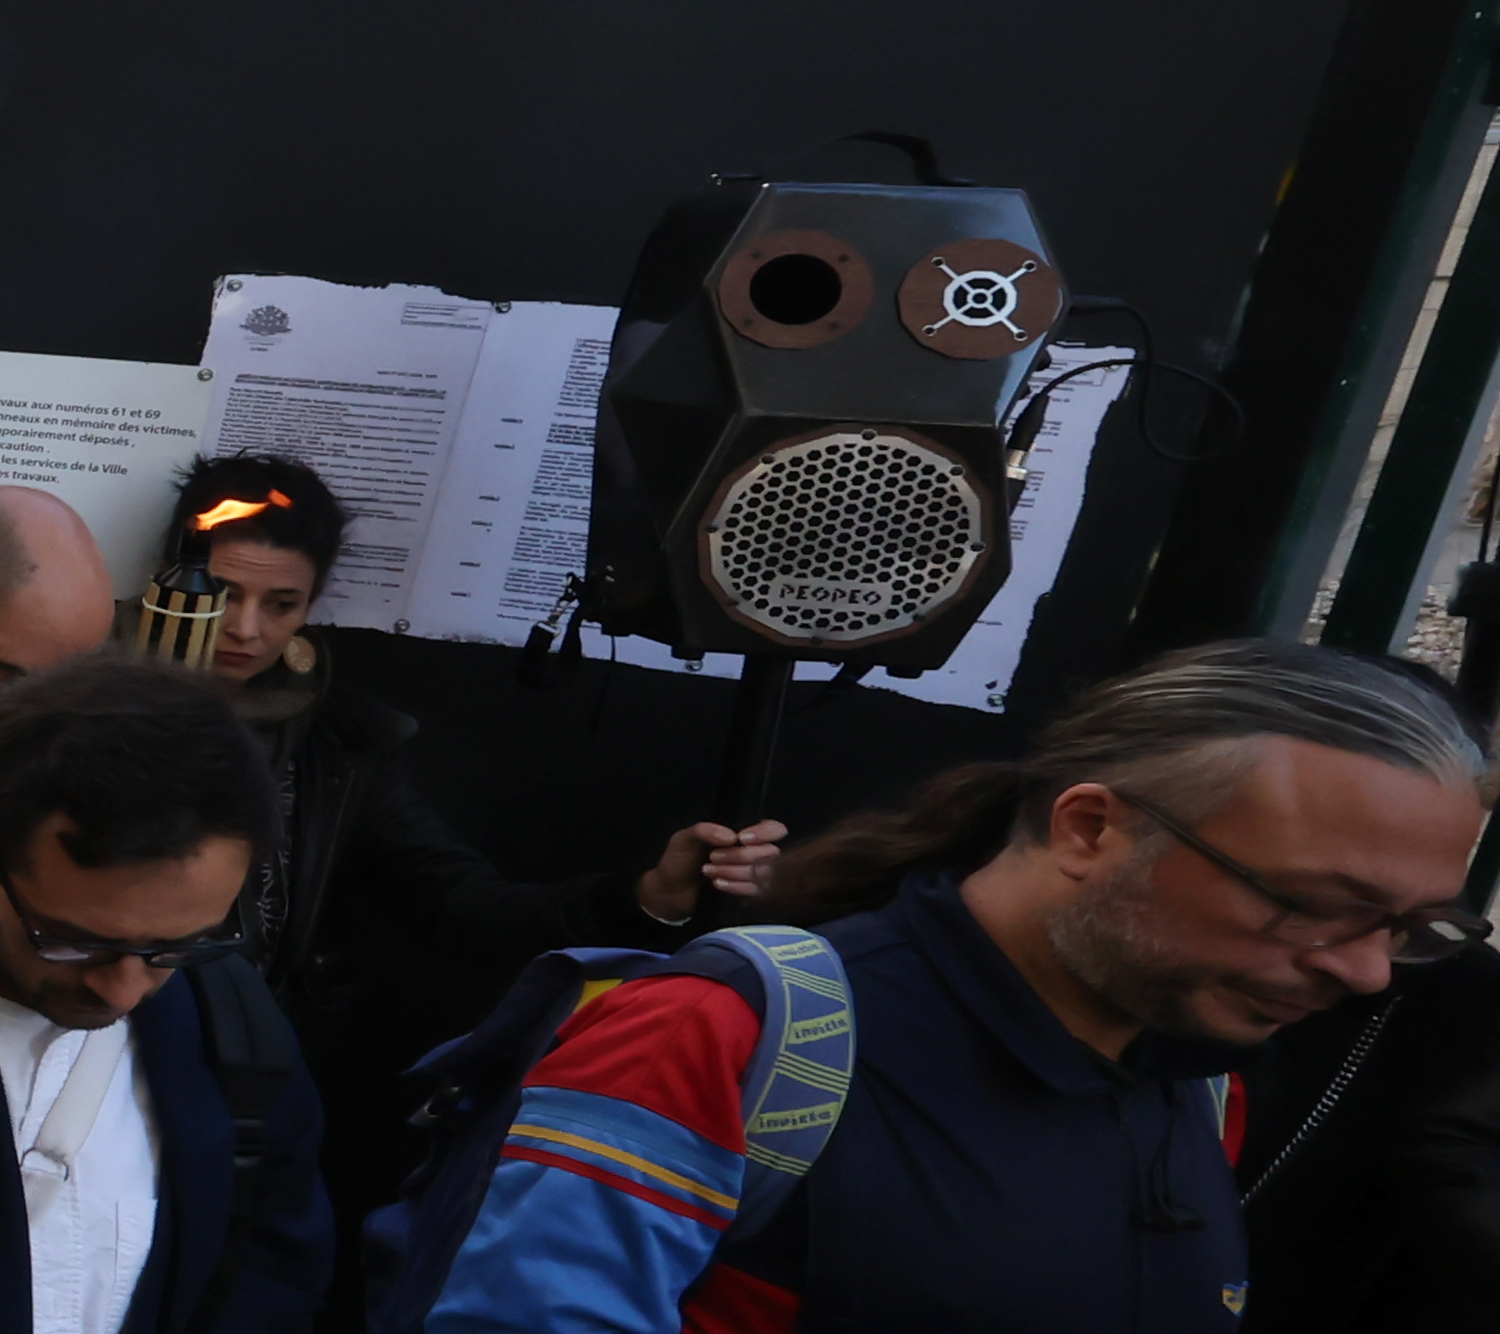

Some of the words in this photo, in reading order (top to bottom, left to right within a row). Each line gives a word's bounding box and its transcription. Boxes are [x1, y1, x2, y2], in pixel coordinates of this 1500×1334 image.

[31, 401, 52, 410] aux
[56, 403, 109, 416] numéros
[111, 406, 126, 417] 61
[129, 409, 142, 419] et
[145, 409, 161, 420] 69
[43, 416, 58, 426] en
[61, 418, 116, 431] mémoire
[118, 423, 140, 433] des
[143, 425, 197, 438] victimes,
[2, 455, 18, 465] les
[20, 458, 67, 470] services
[70, 461, 85, 471] de
[88, 463, 100, 472] la
[102, 464, 128, 475] Ville
[12, 472, 60, 483] travaux.
[779, 584, 882, 605] PEOPEO
[794, 1018, 847, 1039] invicta
[759, 1110, 831, 1129] invicta
